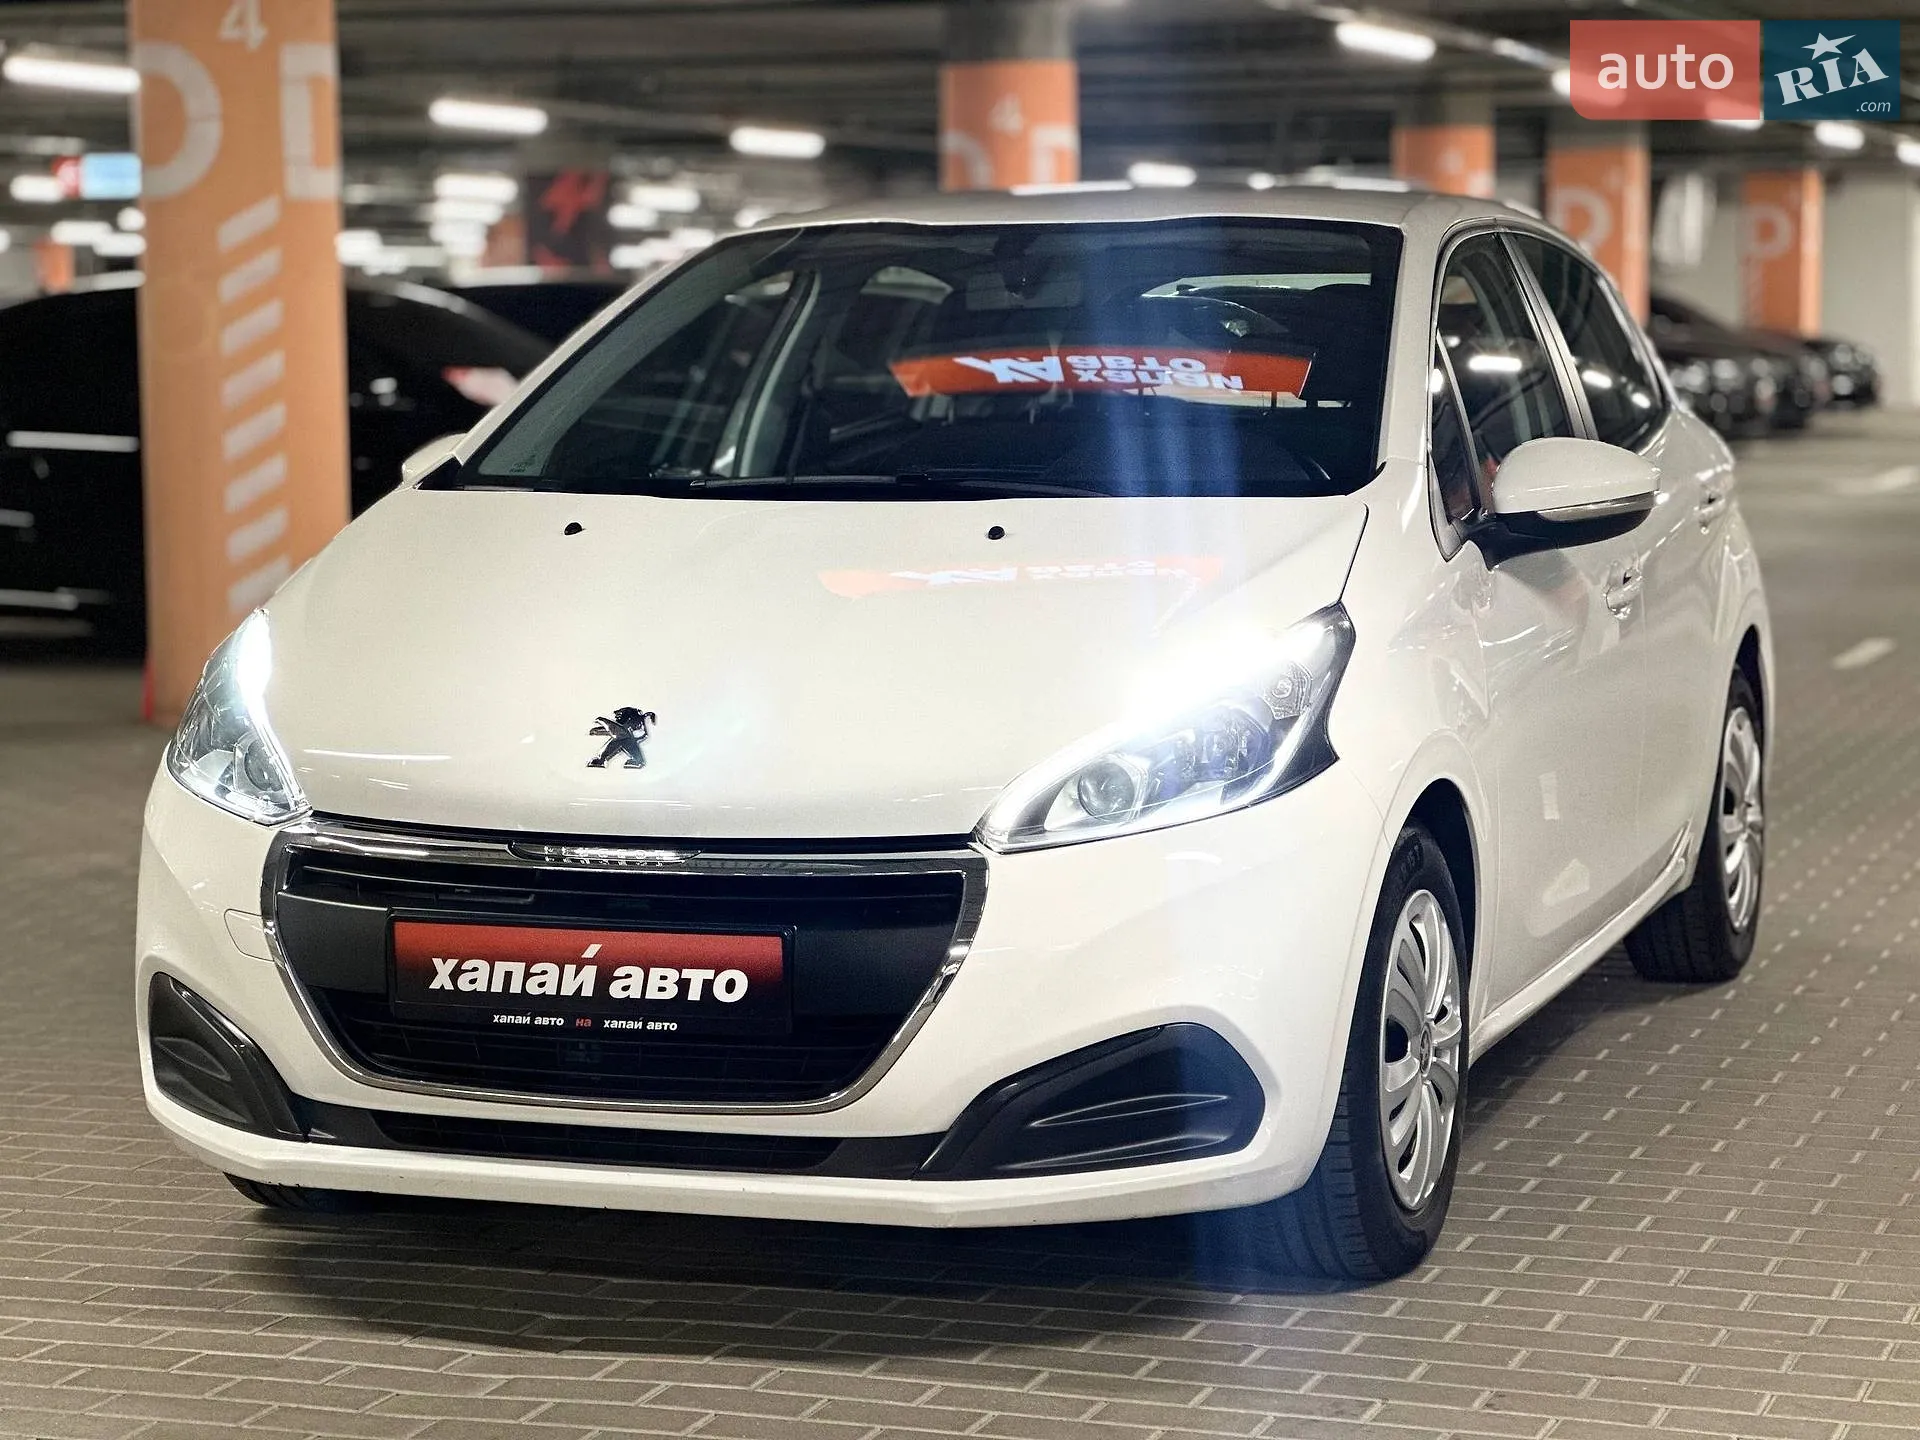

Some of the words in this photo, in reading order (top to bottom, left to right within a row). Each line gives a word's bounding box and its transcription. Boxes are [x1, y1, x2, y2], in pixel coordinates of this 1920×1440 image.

[217, 0, 268, 51] 4
[608, 964, 749, 1004] авто
[534, 1015, 565, 1027] авто
[575, 1016, 592, 1028] на
[646, 1019, 678, 1032] авто
